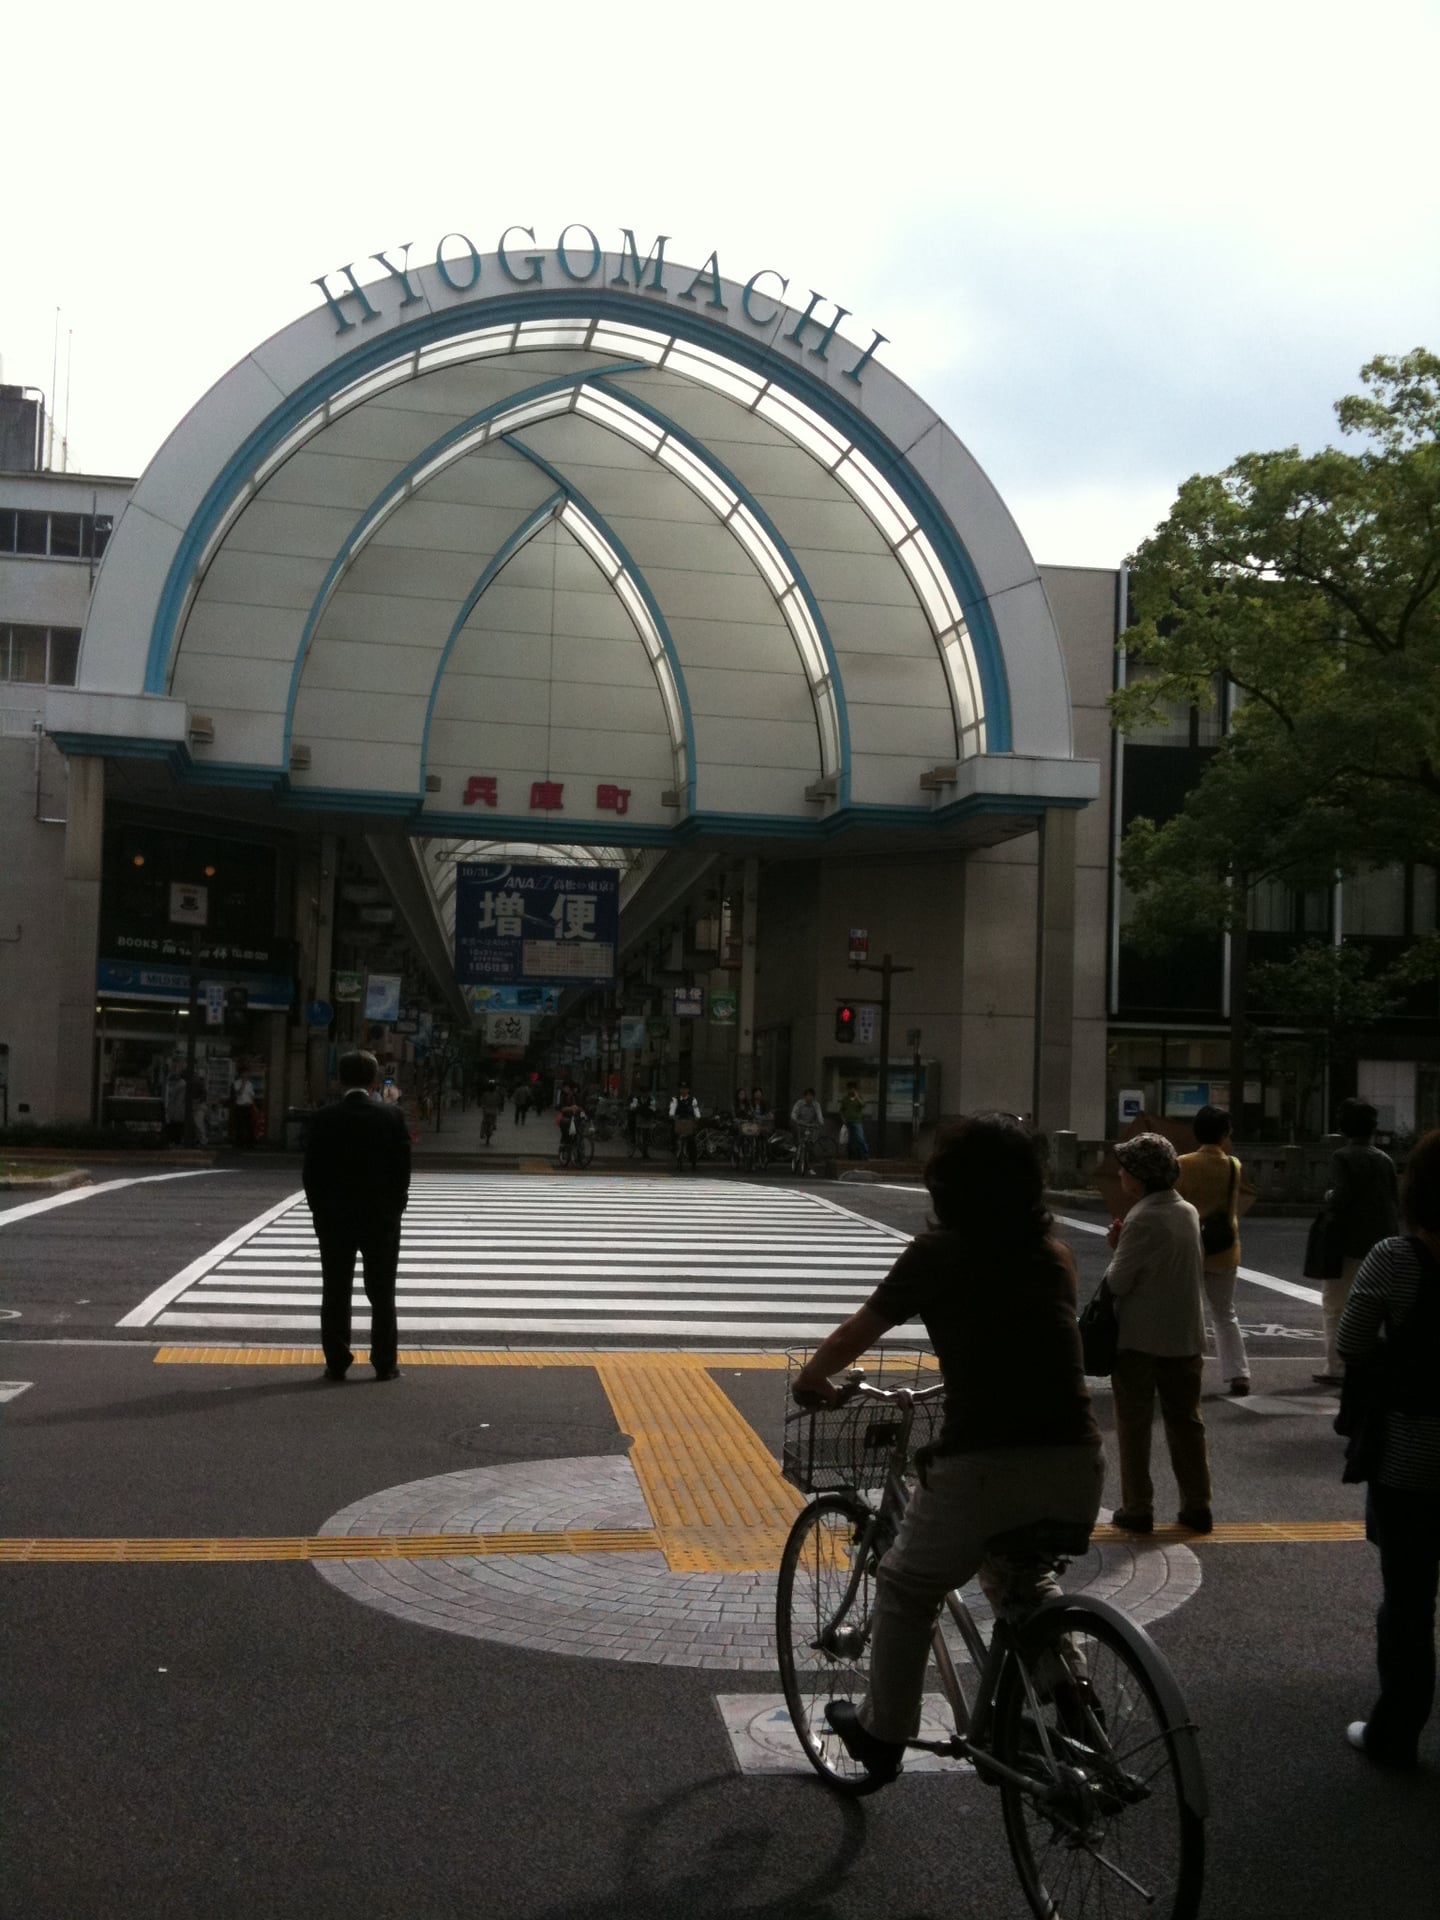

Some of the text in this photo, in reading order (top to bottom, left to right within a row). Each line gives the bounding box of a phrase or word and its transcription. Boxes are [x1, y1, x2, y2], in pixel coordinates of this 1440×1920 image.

[310, 223, 891, 386] HYOGOMACHI
[463, 776, 631, 815] 兵庫町
[504, 877, 535, 889] ANA
[117, 935, 159, 949] BOOKS
